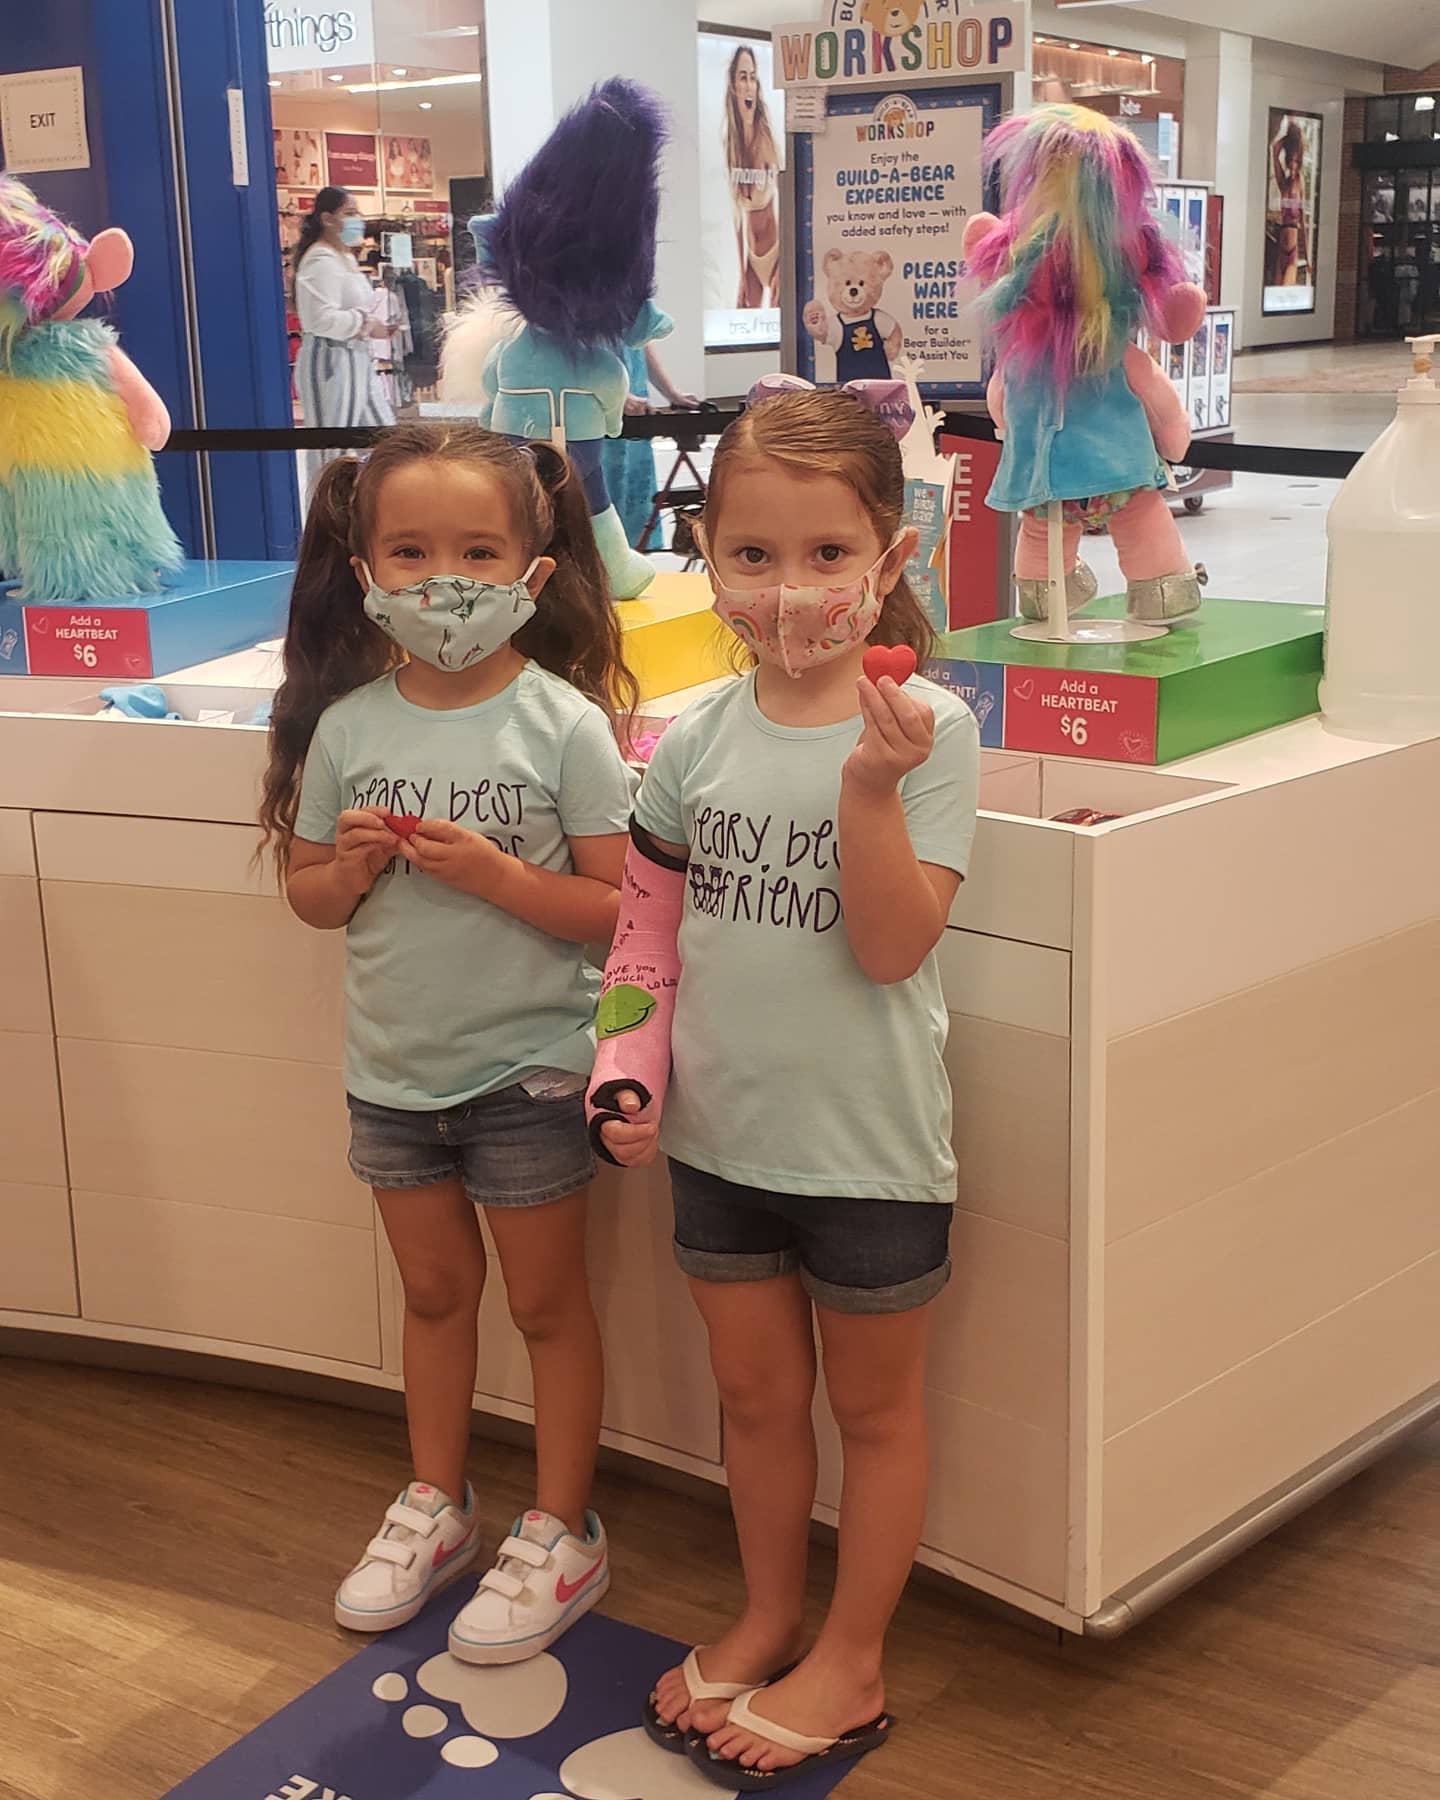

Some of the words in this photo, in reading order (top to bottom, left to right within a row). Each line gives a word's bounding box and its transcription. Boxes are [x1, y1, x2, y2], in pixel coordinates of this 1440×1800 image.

[780, 17, 1013, 81] WORKSHOP
[30, 112, 56, 128] EXIT
[855, 121, 935, 142] WORKSHOP
[871, 153, 898, 166] Enjoy
[901, 151, 919, 162] the
[836, 164, 955, 186] BUILD-A-BEAR
[845, 185, 945, 205] EXPERIENCE
[826, 213, 845, 224] you
[848, 211, 875, 221] know
[878, 209, 899, 220] and
[902, 208, 926, 219] love
[941, 206, 967, 217] with
[841, 225, 876, 237] added
[879, 224, 914, 237] safety
[916, 223, 950, 236] steps!
[914, 281, 957, 299] WAIT
[912, 301, 958, 319] HERE
[924, 325, 939, 335] for
[941, 327, 949, 335] a
[903, 338, 928, 348] Bear
[906, 351, 917, 360] to
[919, 350, 948, 360] Assist
[950, 350, 969, 360] You
[70, 615, 91, 626] Add
[93, 618, 101, 626] a
[55, 628, 118, 640] HEARTBEAT
[73, 643, 97, 667] $6
[923, 668, 940, 680] dd
[942, 671, 950, 680] a
[1060, 679, 1087, 694] Add
[1088, 684, 1098, 694] a
[1041, 694, 1118, 714] HEARTBEAT
[1060, 714, 1088, 745] $6
